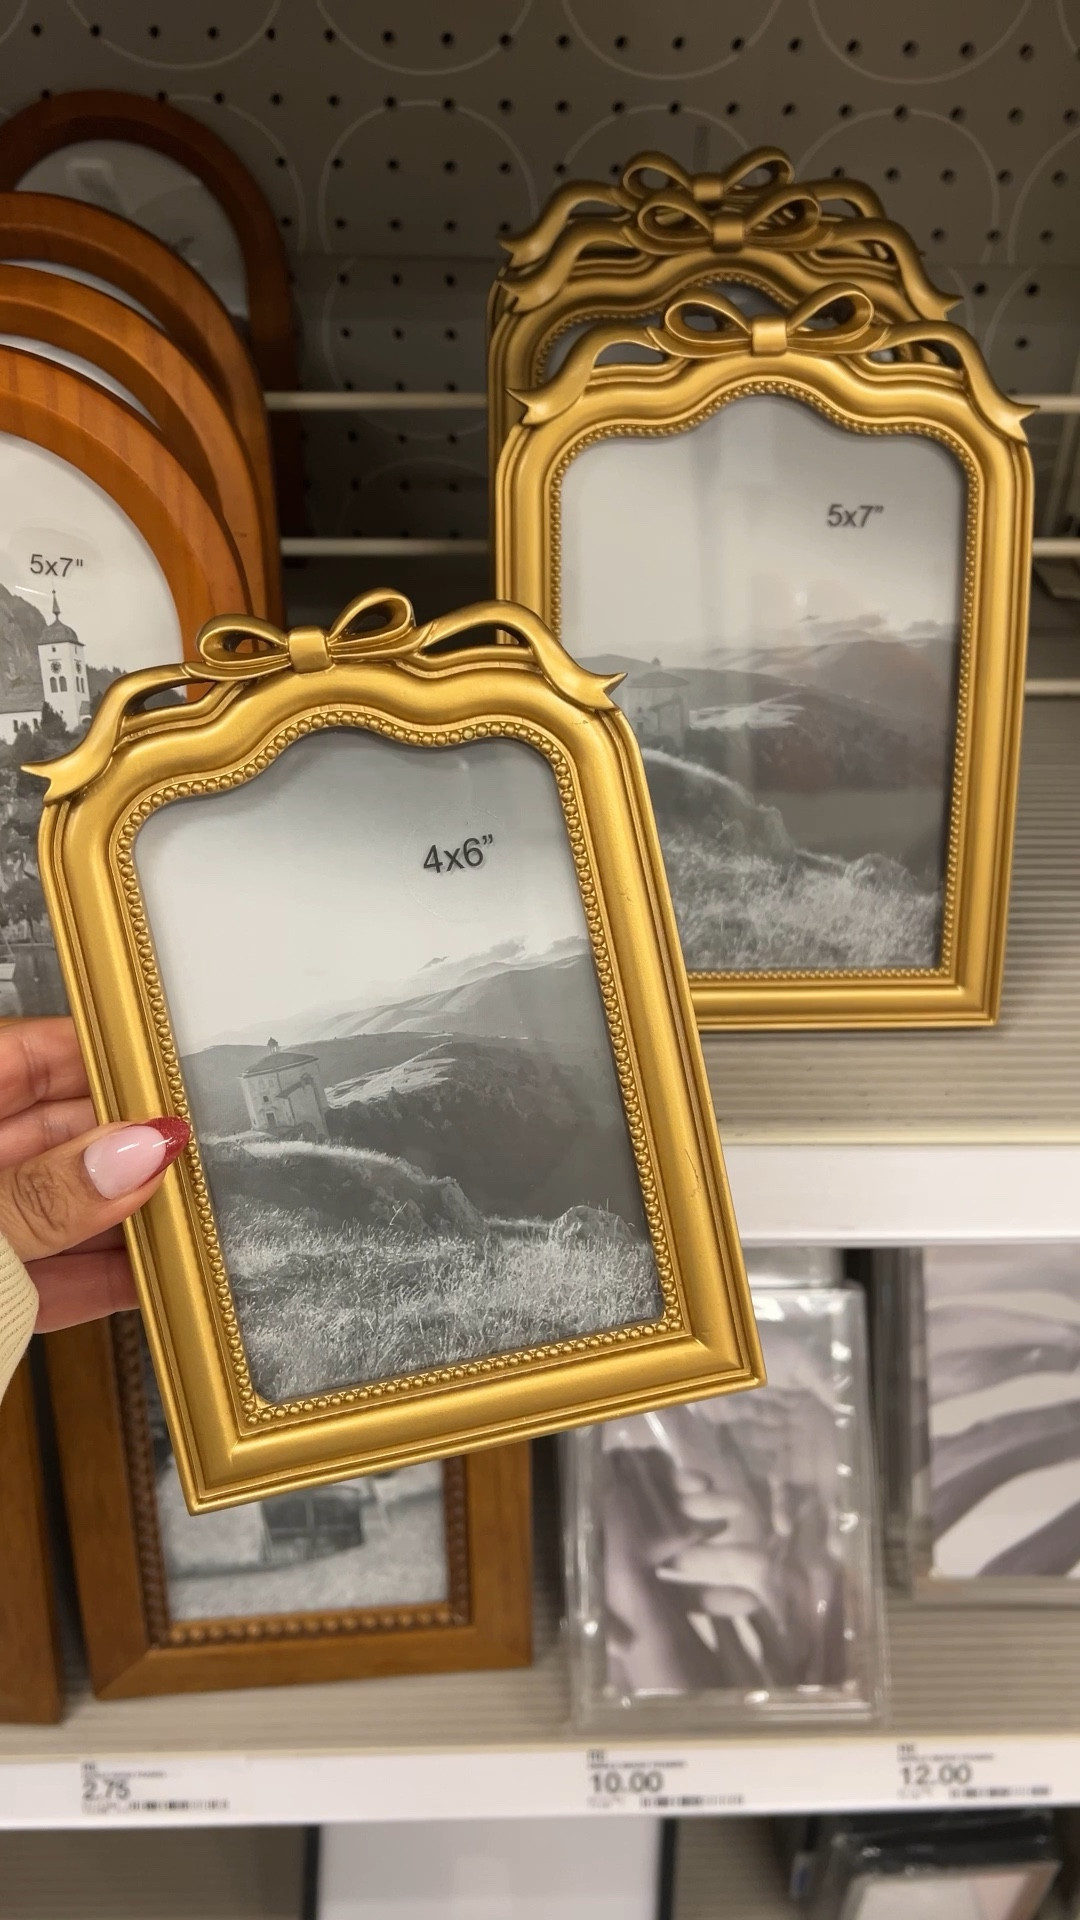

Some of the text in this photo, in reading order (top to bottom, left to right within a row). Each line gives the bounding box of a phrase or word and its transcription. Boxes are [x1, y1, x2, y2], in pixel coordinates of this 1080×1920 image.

[30, 553, 83, 577] 5x7"
[423, 833, 494, 874] 4x6”
[591, 1770, 664, 1794] 10.00
[901, 1763, 972, 1786] 12.00
[82, 1778, 131, 1800] 2.75
